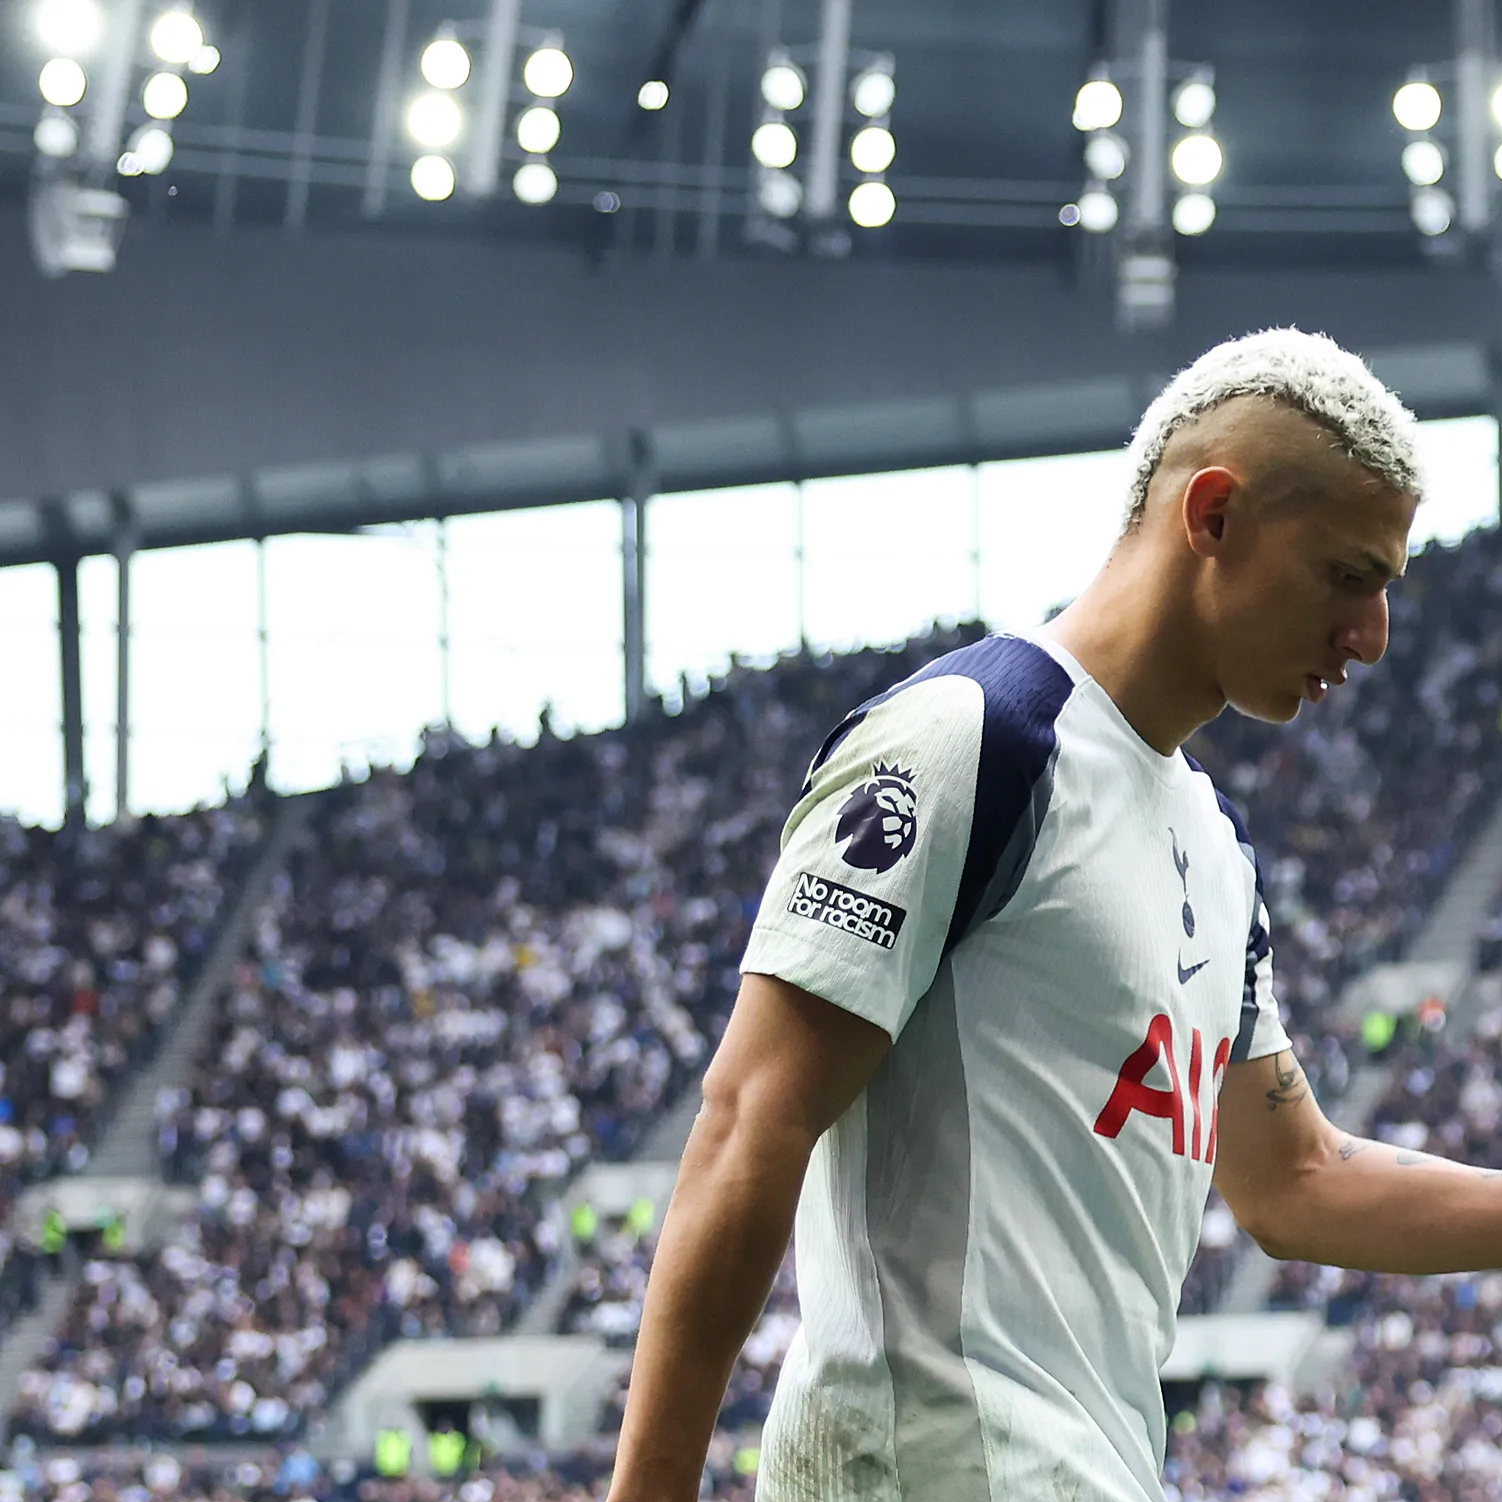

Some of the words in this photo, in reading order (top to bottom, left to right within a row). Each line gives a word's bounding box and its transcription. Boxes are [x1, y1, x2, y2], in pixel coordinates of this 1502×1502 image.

[789, 892, 822, 916] for
[821, 905, 895, 948] racism
[796, 873, 828, 900] No
[830, 889, 892, 926] room
